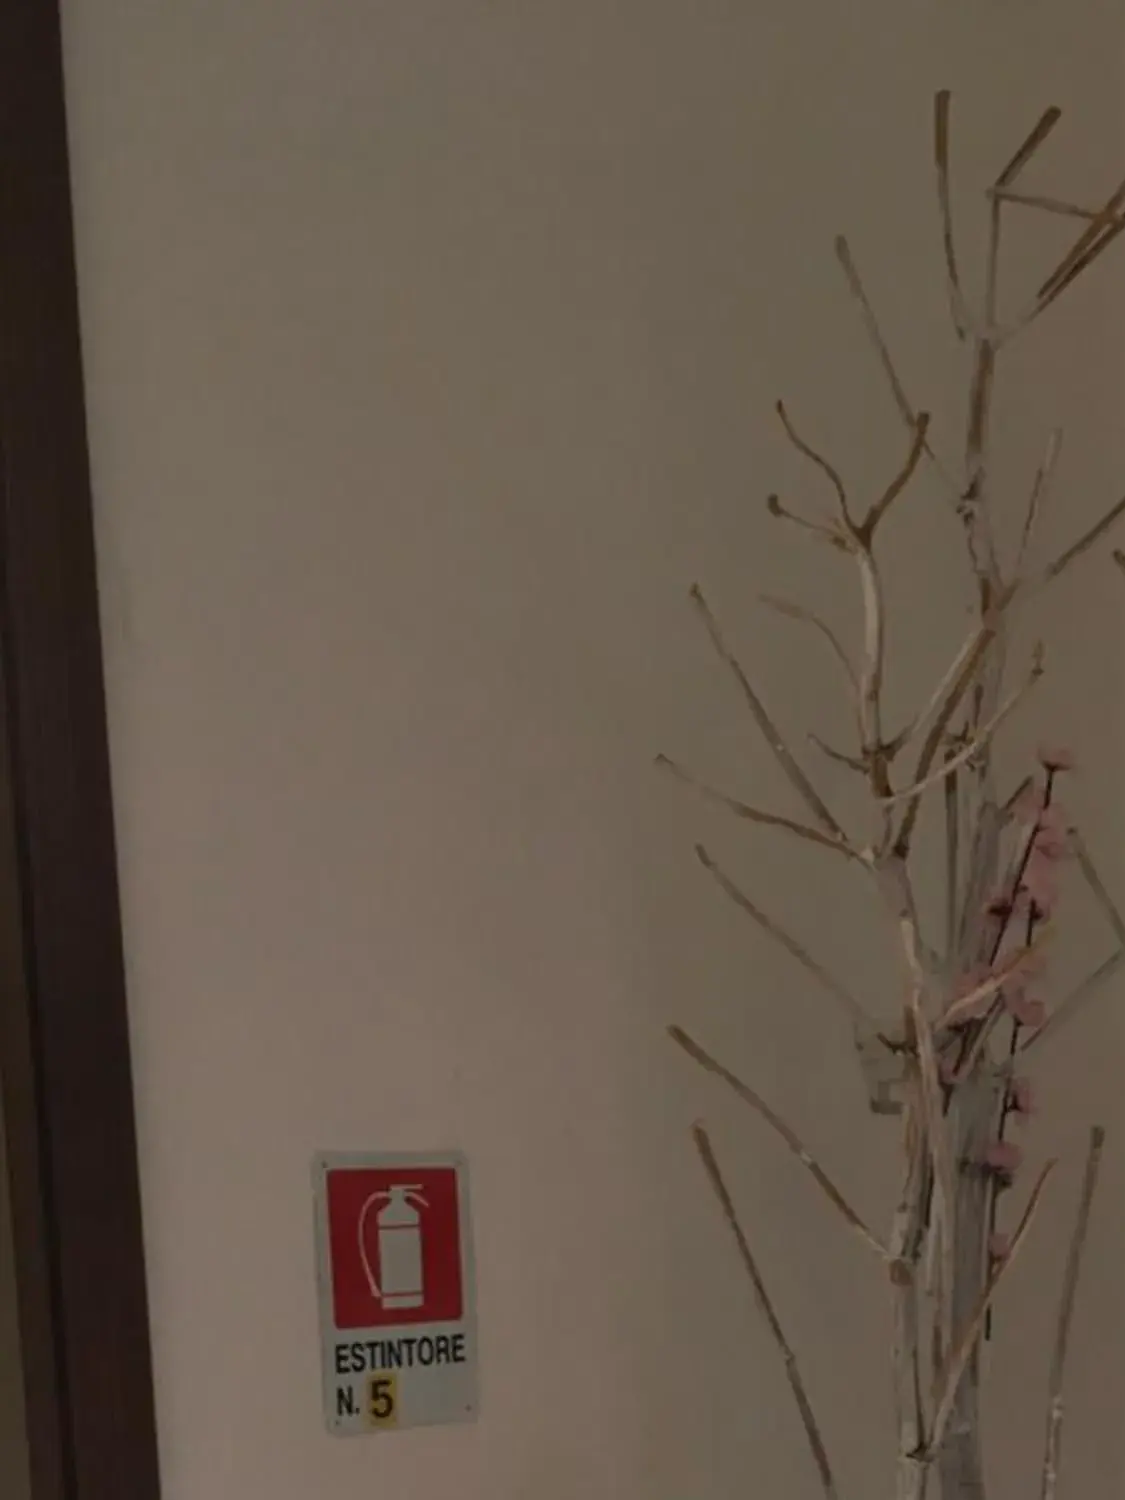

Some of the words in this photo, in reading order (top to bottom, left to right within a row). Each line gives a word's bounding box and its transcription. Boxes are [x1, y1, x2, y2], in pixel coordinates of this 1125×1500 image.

[335, 1334, 466, 1374] ESTINTORE
[336, 1385, 360, 1416] N.
[370, 1380, 394, 1419] 5
